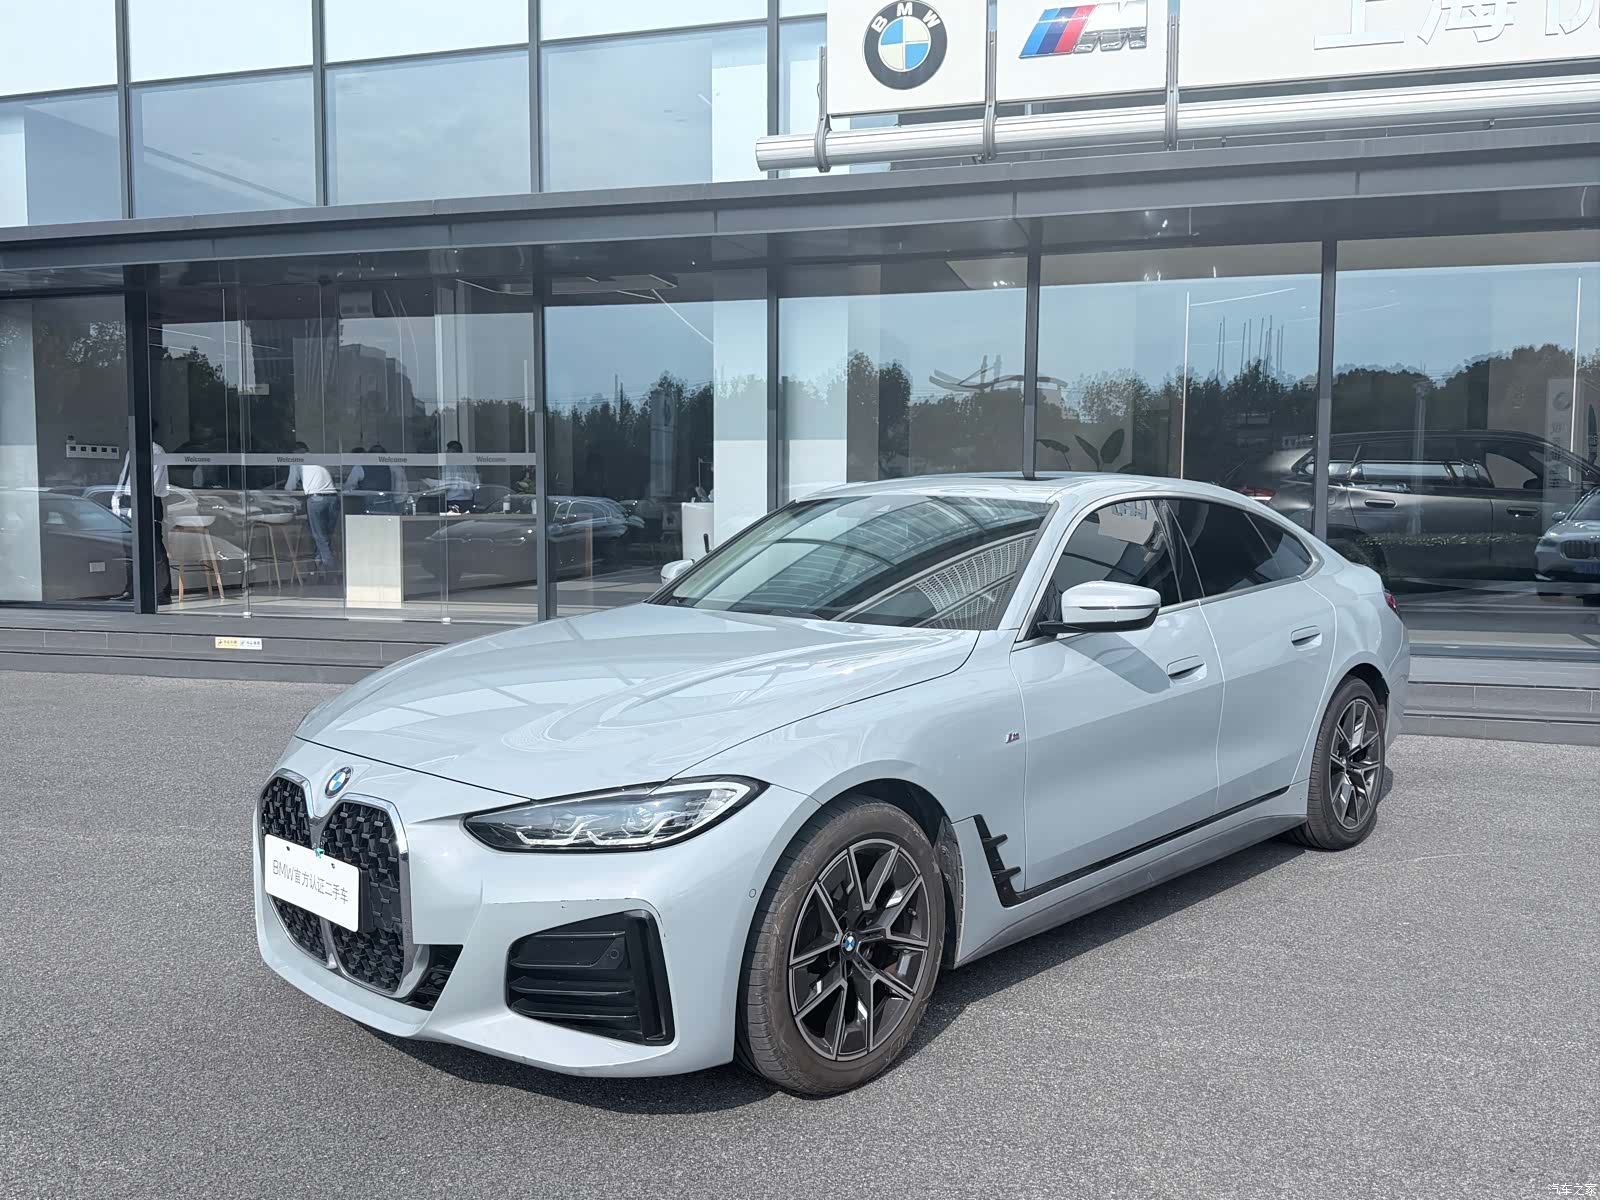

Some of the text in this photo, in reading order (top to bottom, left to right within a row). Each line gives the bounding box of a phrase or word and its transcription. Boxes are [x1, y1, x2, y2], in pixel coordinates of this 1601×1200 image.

[871, 1, 942, 34] BMW
[378, 456, 408, 464] Welcome
[272, 859, 348, 904] BMW官方认证二手车
